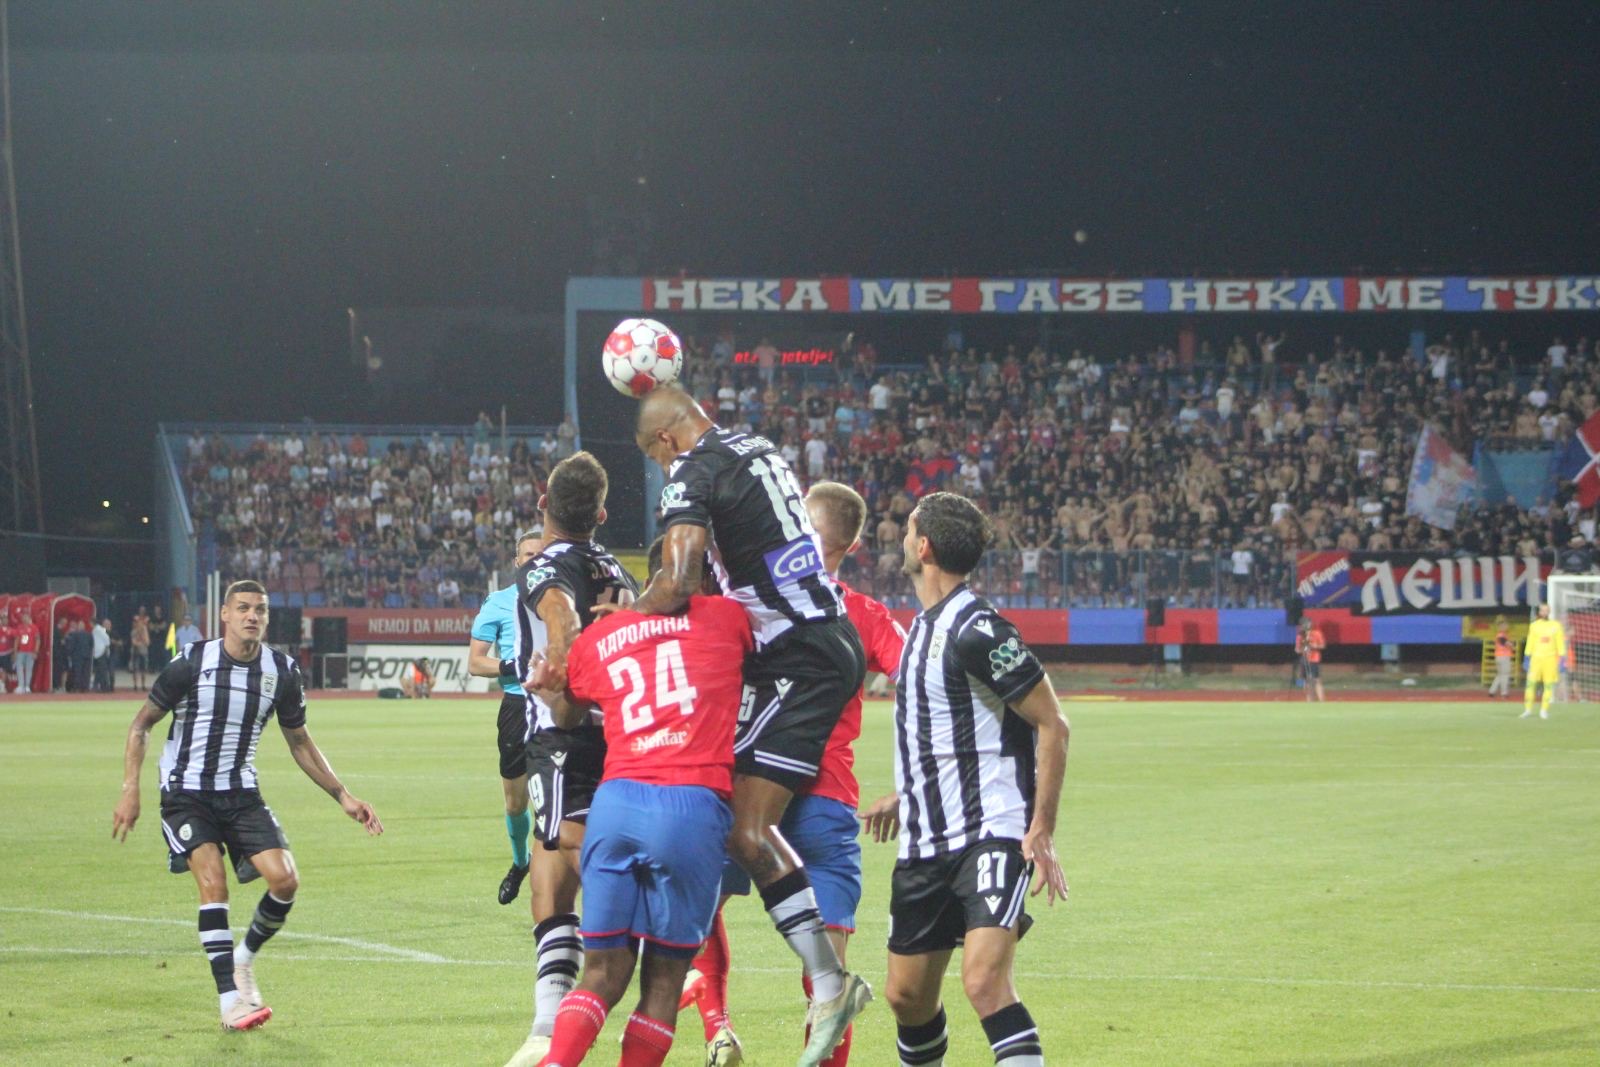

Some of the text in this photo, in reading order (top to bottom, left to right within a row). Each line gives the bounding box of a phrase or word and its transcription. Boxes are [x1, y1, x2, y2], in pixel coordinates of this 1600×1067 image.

[654, 280, 829, 311] НЕКА
[860, 282, 951, 311] МЕ
[979, 281, 1144, 312] ГАЗЕ
[1168, 280, 1337, 311] НЕКА
[1359, 280, 1443, 310] МЕ
[368, 613, 471, 634] NEMOJ DA MRAČ
[606, 639, 698, 735] 24
[976, 851, 1008, 893] 27
